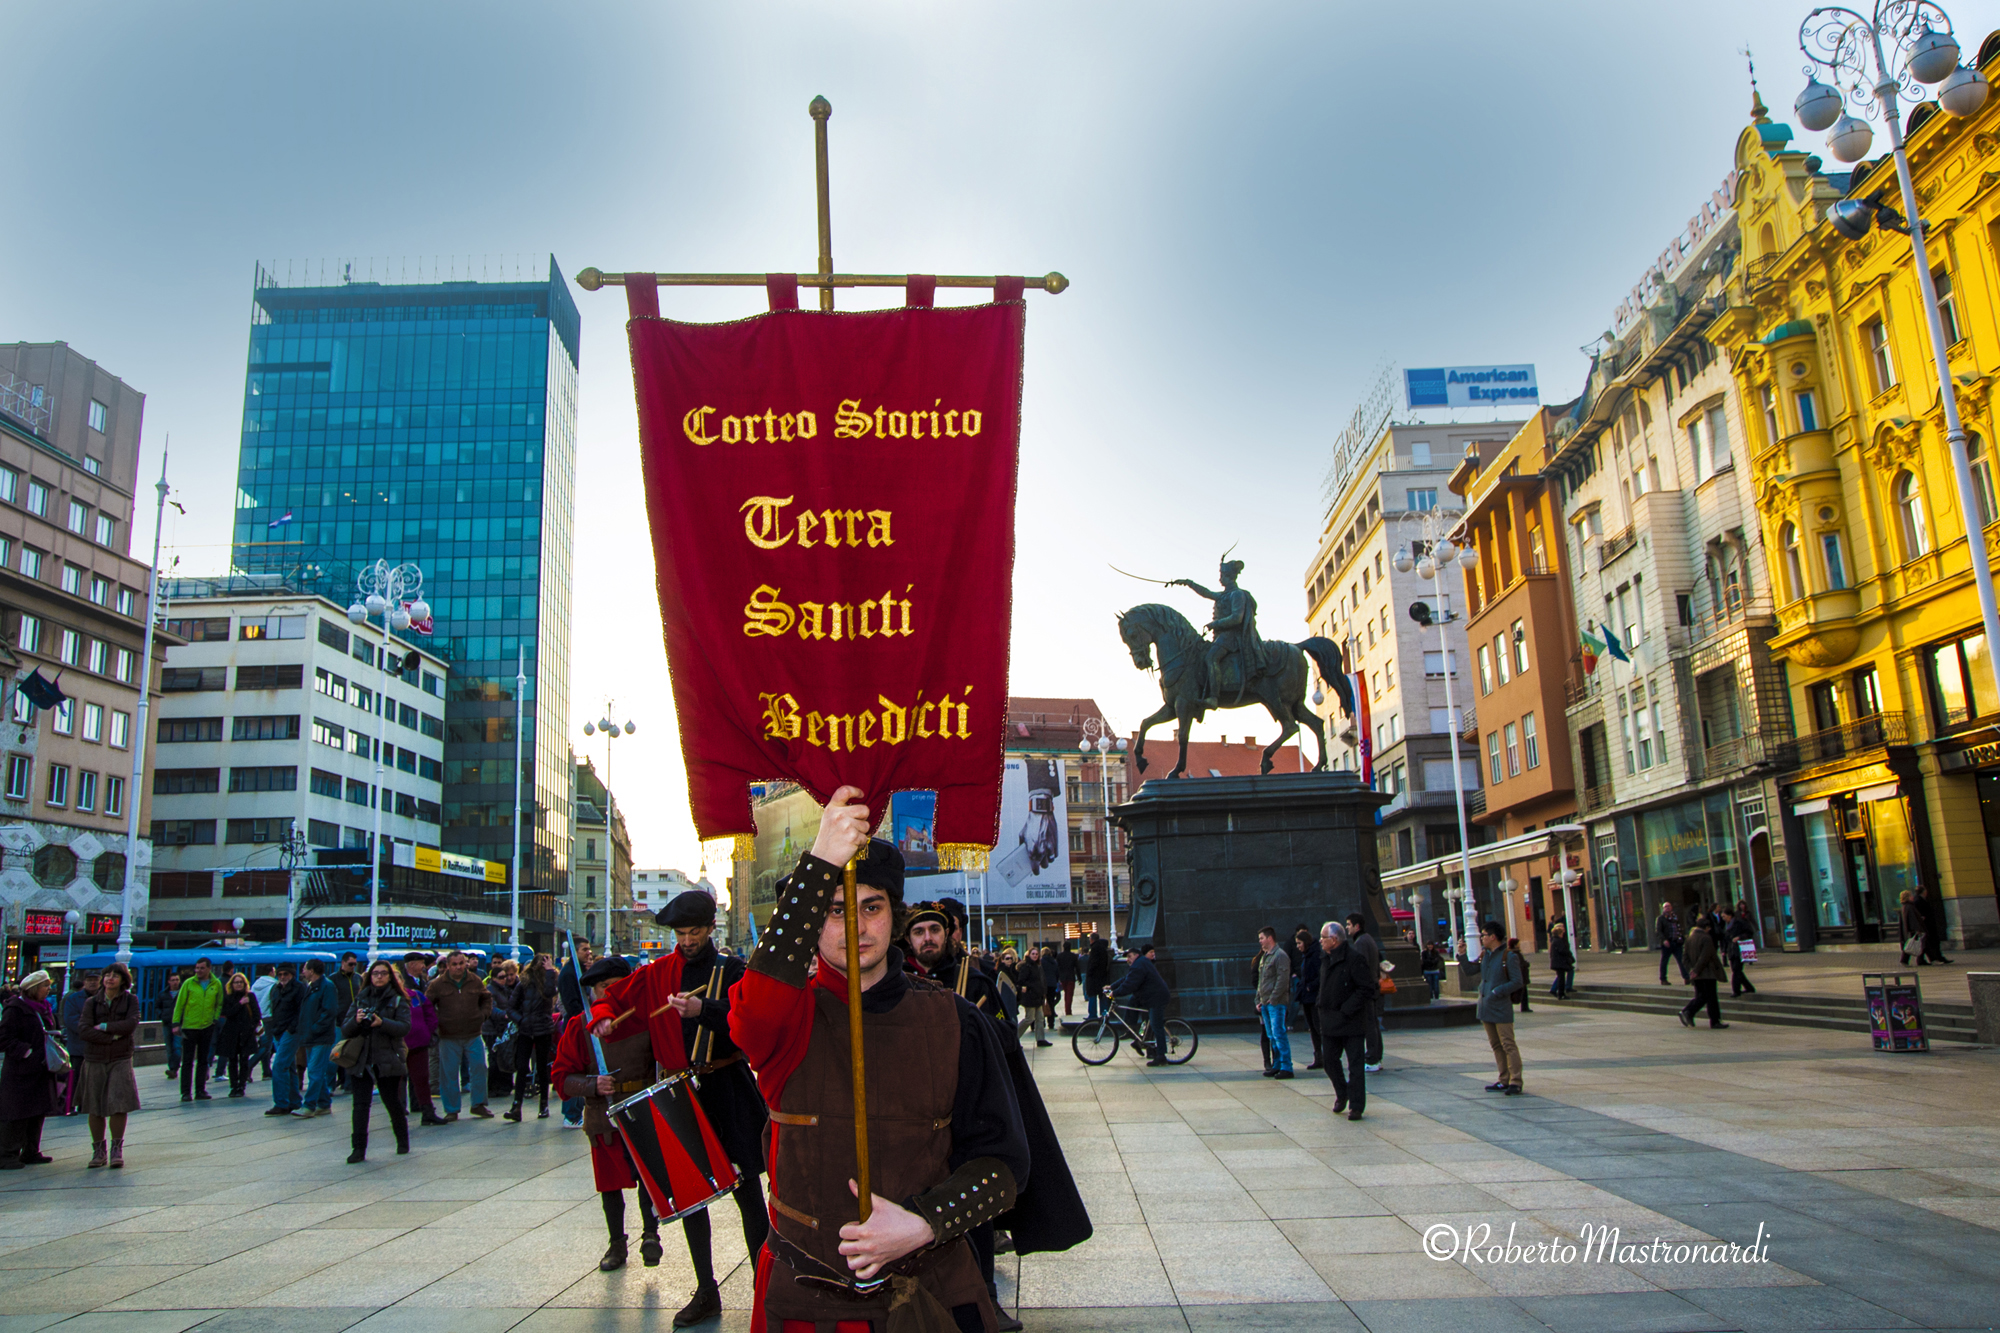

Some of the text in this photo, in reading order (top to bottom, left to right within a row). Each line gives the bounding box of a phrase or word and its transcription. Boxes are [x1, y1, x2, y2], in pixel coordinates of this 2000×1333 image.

[1448, 368, 1529, 384] American
[1469, 385, 1539, 402] Express
[682, 397, 983, 446] Corteo Storico
[738, 494, 896, 550] Terra
[743, 583, 915, 642] Sancti
[758, 684, 974, 753] Benedicti
[448, 860, 471, 873] Raiffeisen
[471, 864, 484, 876] BANK
